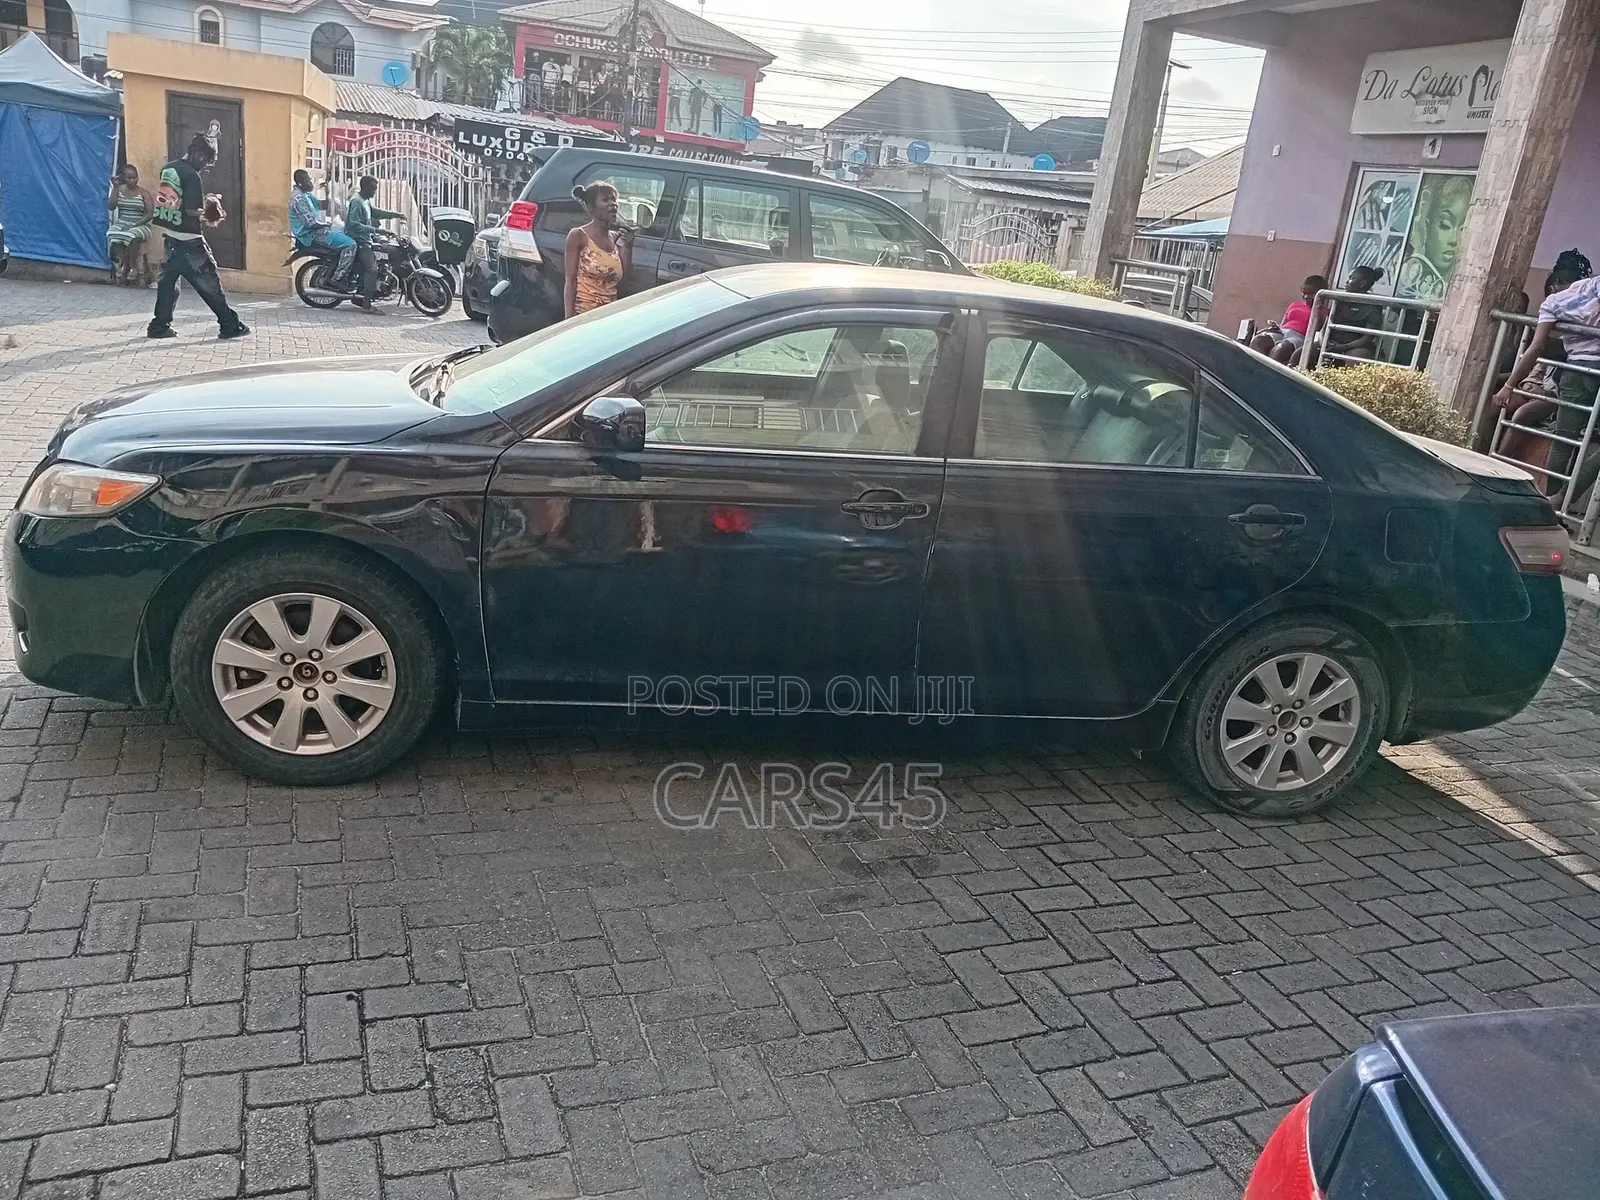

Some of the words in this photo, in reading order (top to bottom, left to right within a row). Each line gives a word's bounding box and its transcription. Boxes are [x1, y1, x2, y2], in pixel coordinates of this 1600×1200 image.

[1363, 69, 1399, 101] Da
[1401, 66, 1468, 100] Lotus
[1423, 106, 1439, 115] SIGN
[1466, 110, 1491, 119] UNISEX
[458, 131, 543, 153] LUXUR
[504, 127, 521, 140] G
[530, 130, 547, 144] &
[558, 134, 574, 148] D
